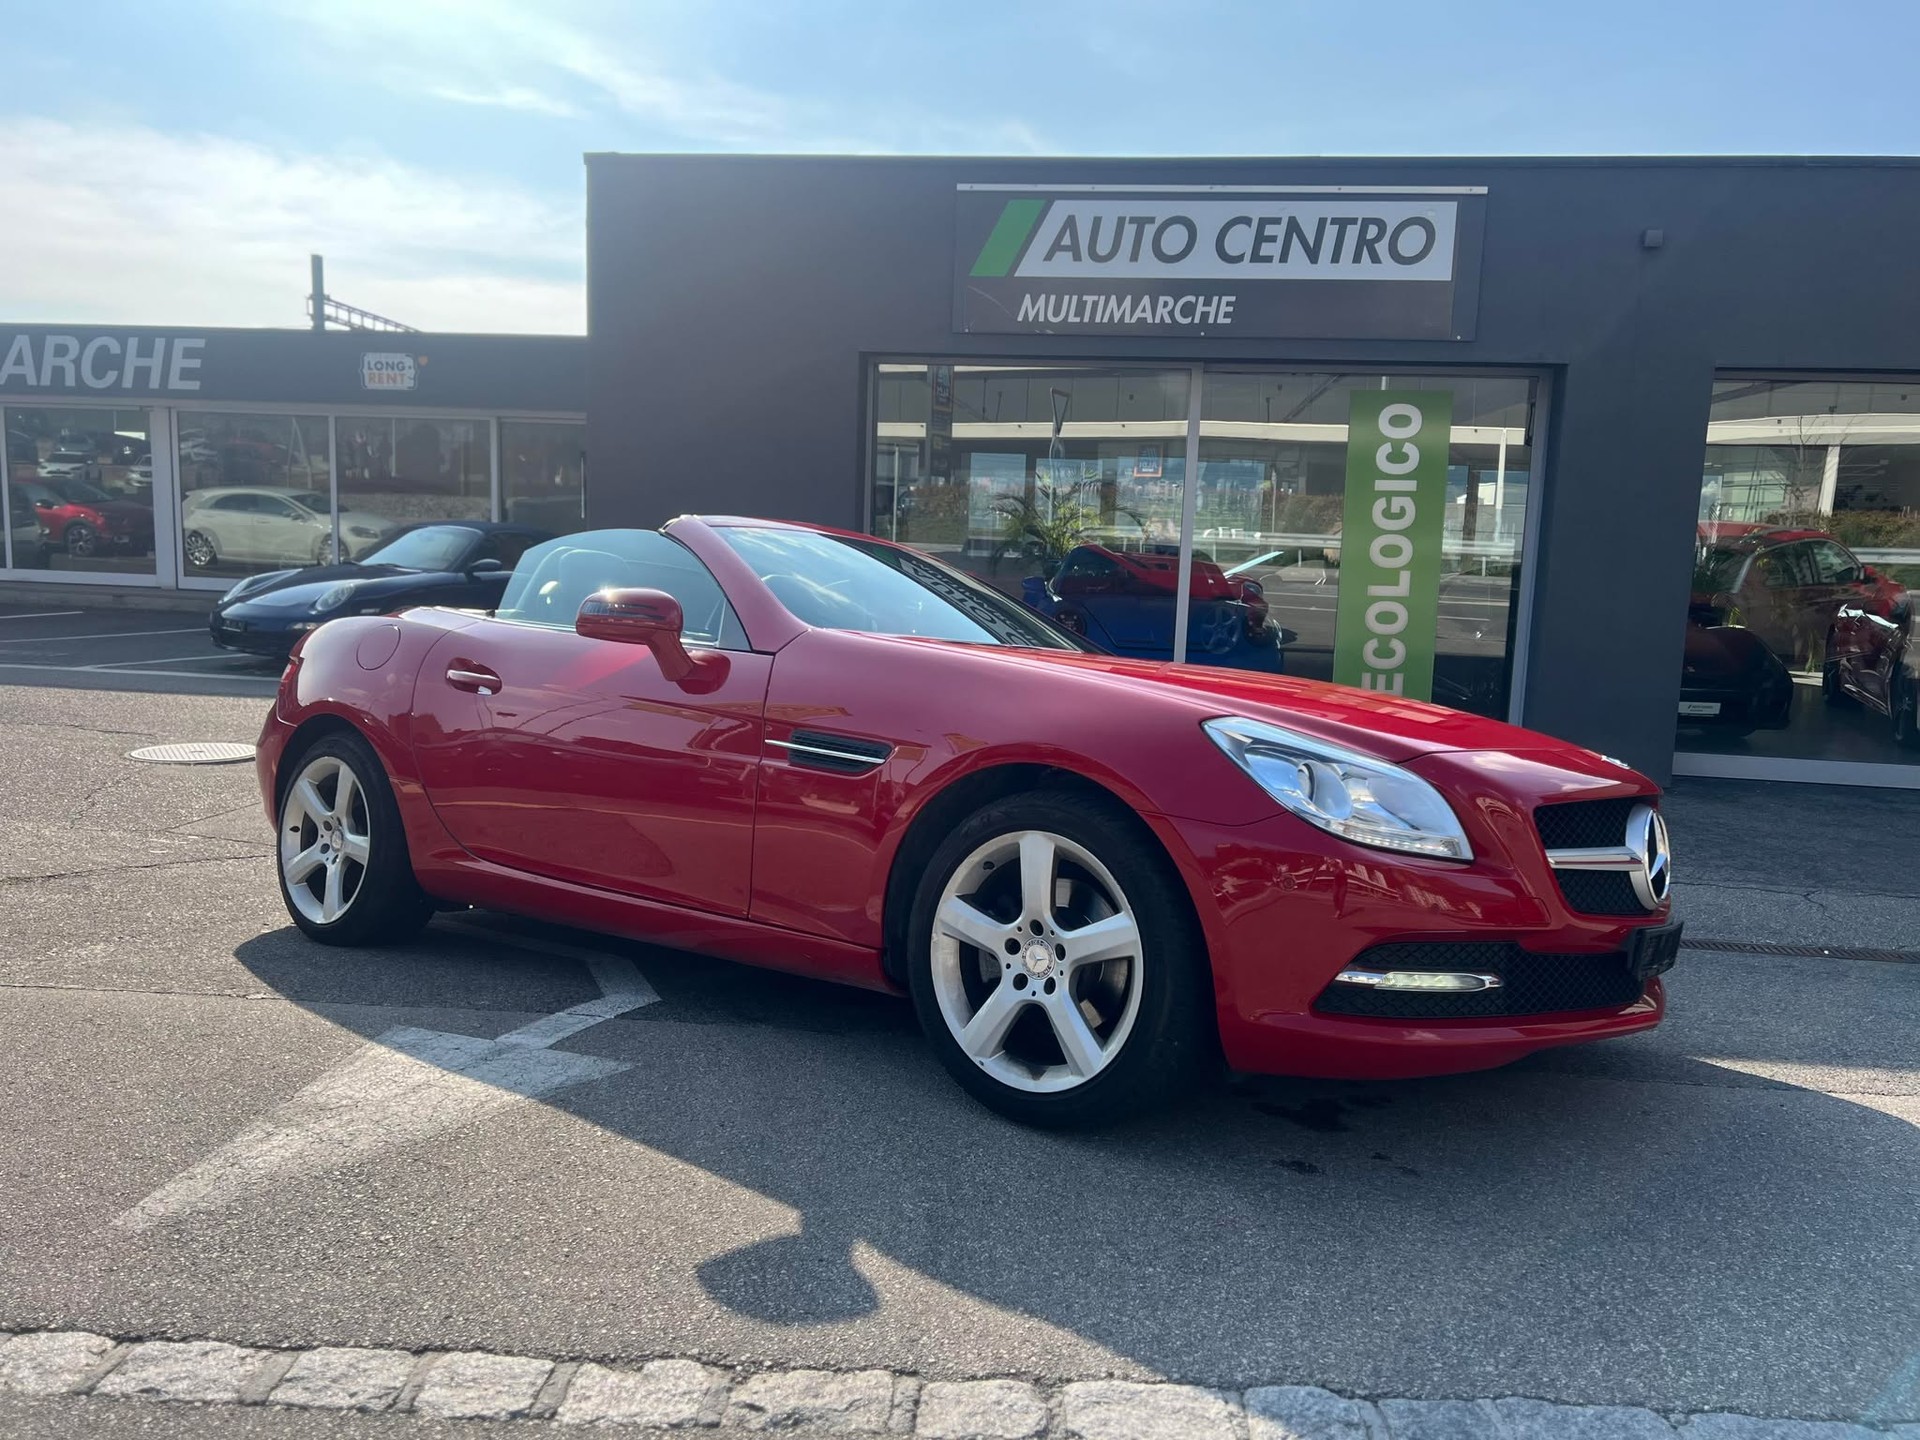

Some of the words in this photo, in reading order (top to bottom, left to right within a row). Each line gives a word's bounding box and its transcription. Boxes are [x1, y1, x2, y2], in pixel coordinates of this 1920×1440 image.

[1043, 214, 1197, 264] AUTO
[1215, 215, 1436, 266] CENTRO
[1017, 294, 1236, 325] MULTIMARCHE
[0, 334, 206, 390] ARCHE
[367, 360, 406, 371] LONG
[367, 372, 405, 385] RENT
[1361, 403, 1423, 697] ECOLOGICO
